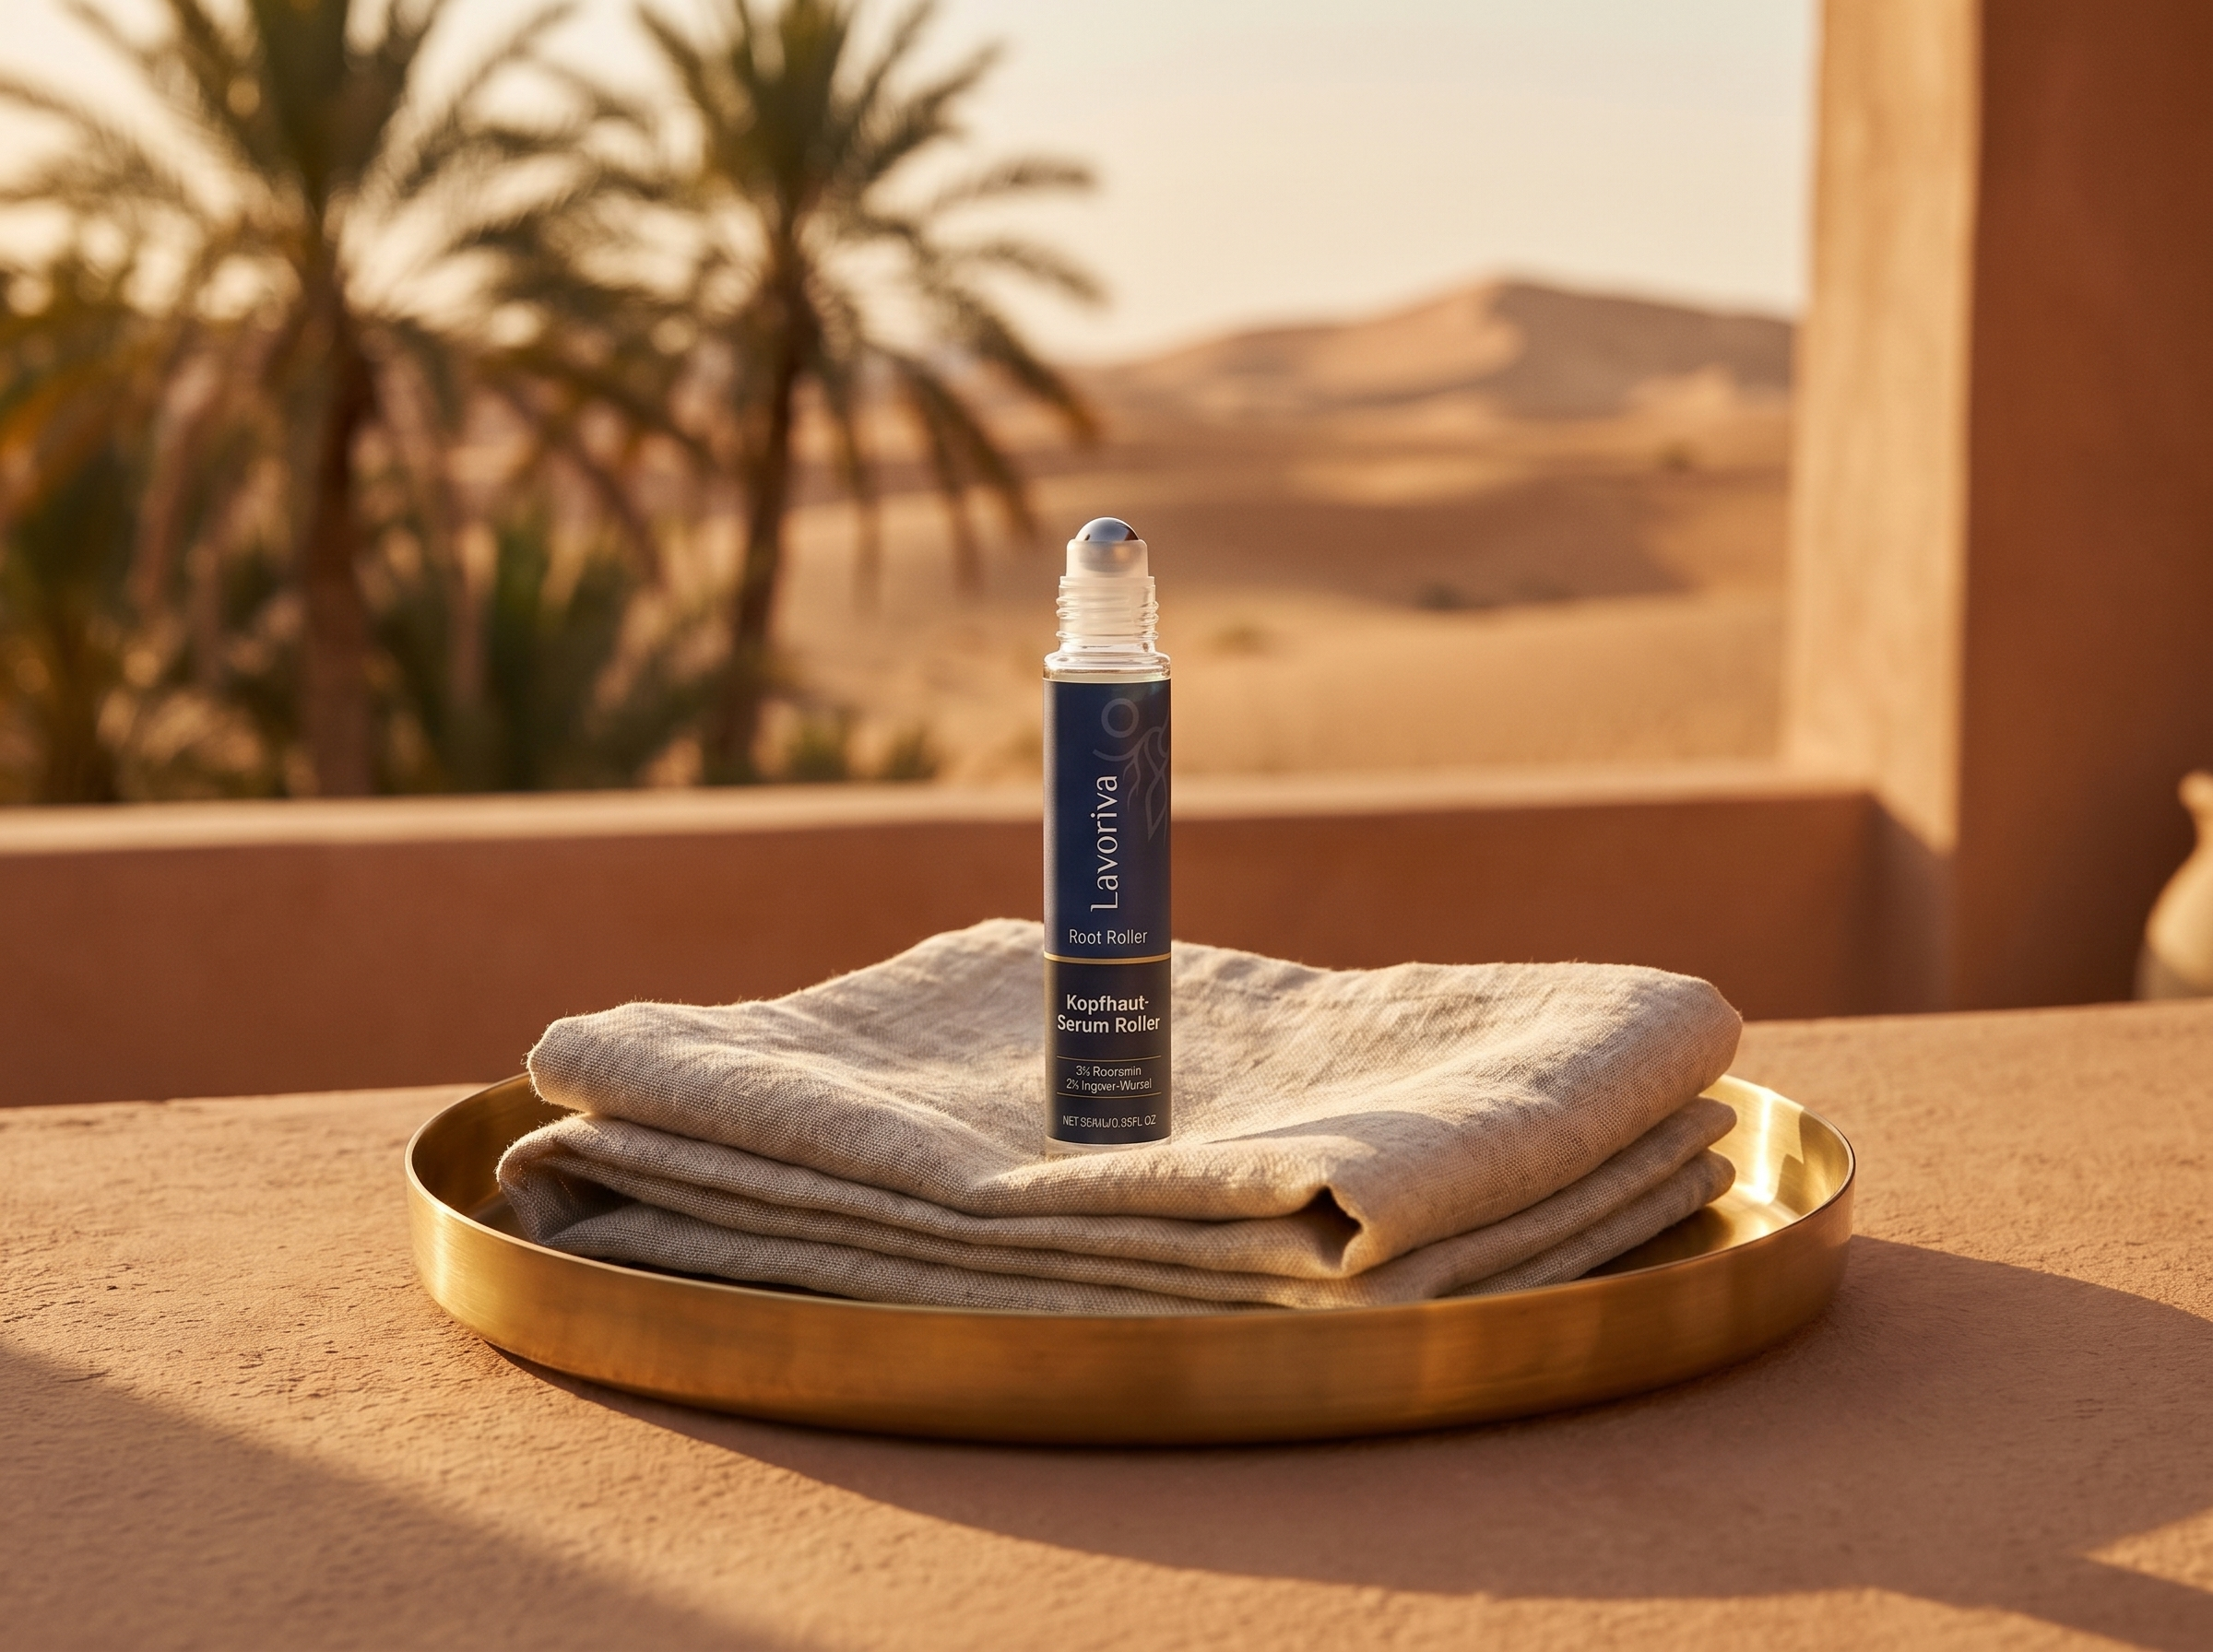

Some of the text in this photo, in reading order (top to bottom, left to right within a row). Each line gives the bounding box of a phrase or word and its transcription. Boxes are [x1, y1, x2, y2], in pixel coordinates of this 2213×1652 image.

[1090, 775, 1118, 912] Lavoriva
[1069, 928, 1148, 945] Root Roller
[1066, 994, 1150, 1015] Kopfhaut-
[1057, 1014, 1161, 1033] Serum Roller
[1062, 1115, 1079, 1127] NET
